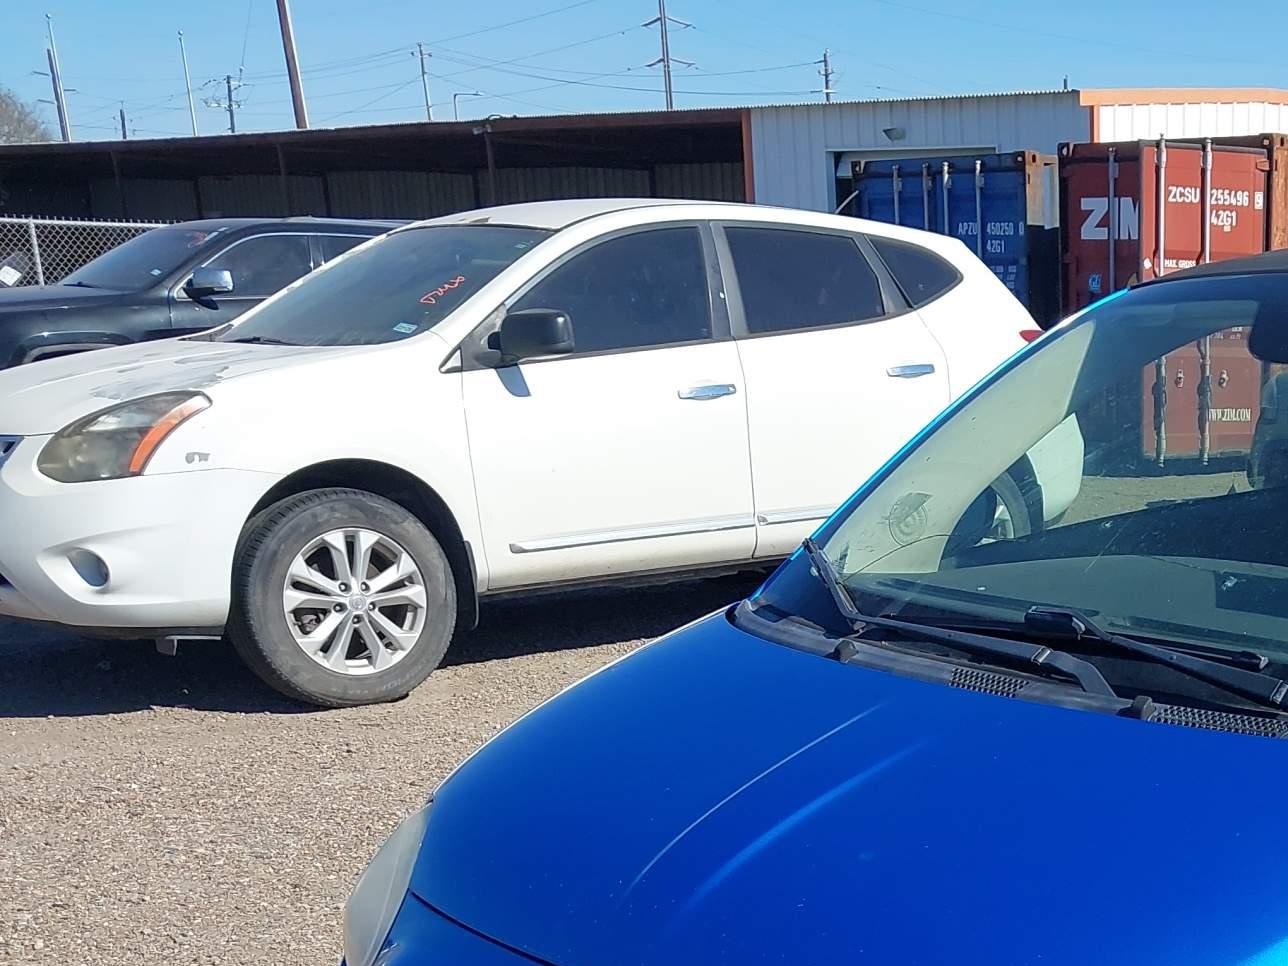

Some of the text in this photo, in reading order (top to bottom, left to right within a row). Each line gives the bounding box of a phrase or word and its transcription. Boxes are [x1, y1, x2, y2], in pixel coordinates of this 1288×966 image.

[1168, 186, 1264, 209] ZCSU 255496 9
[1210, 211, 1236, 226] 42G1
[987, 222, 1014, 235] 450250
[987, 240, 1005, 253] 42G1
